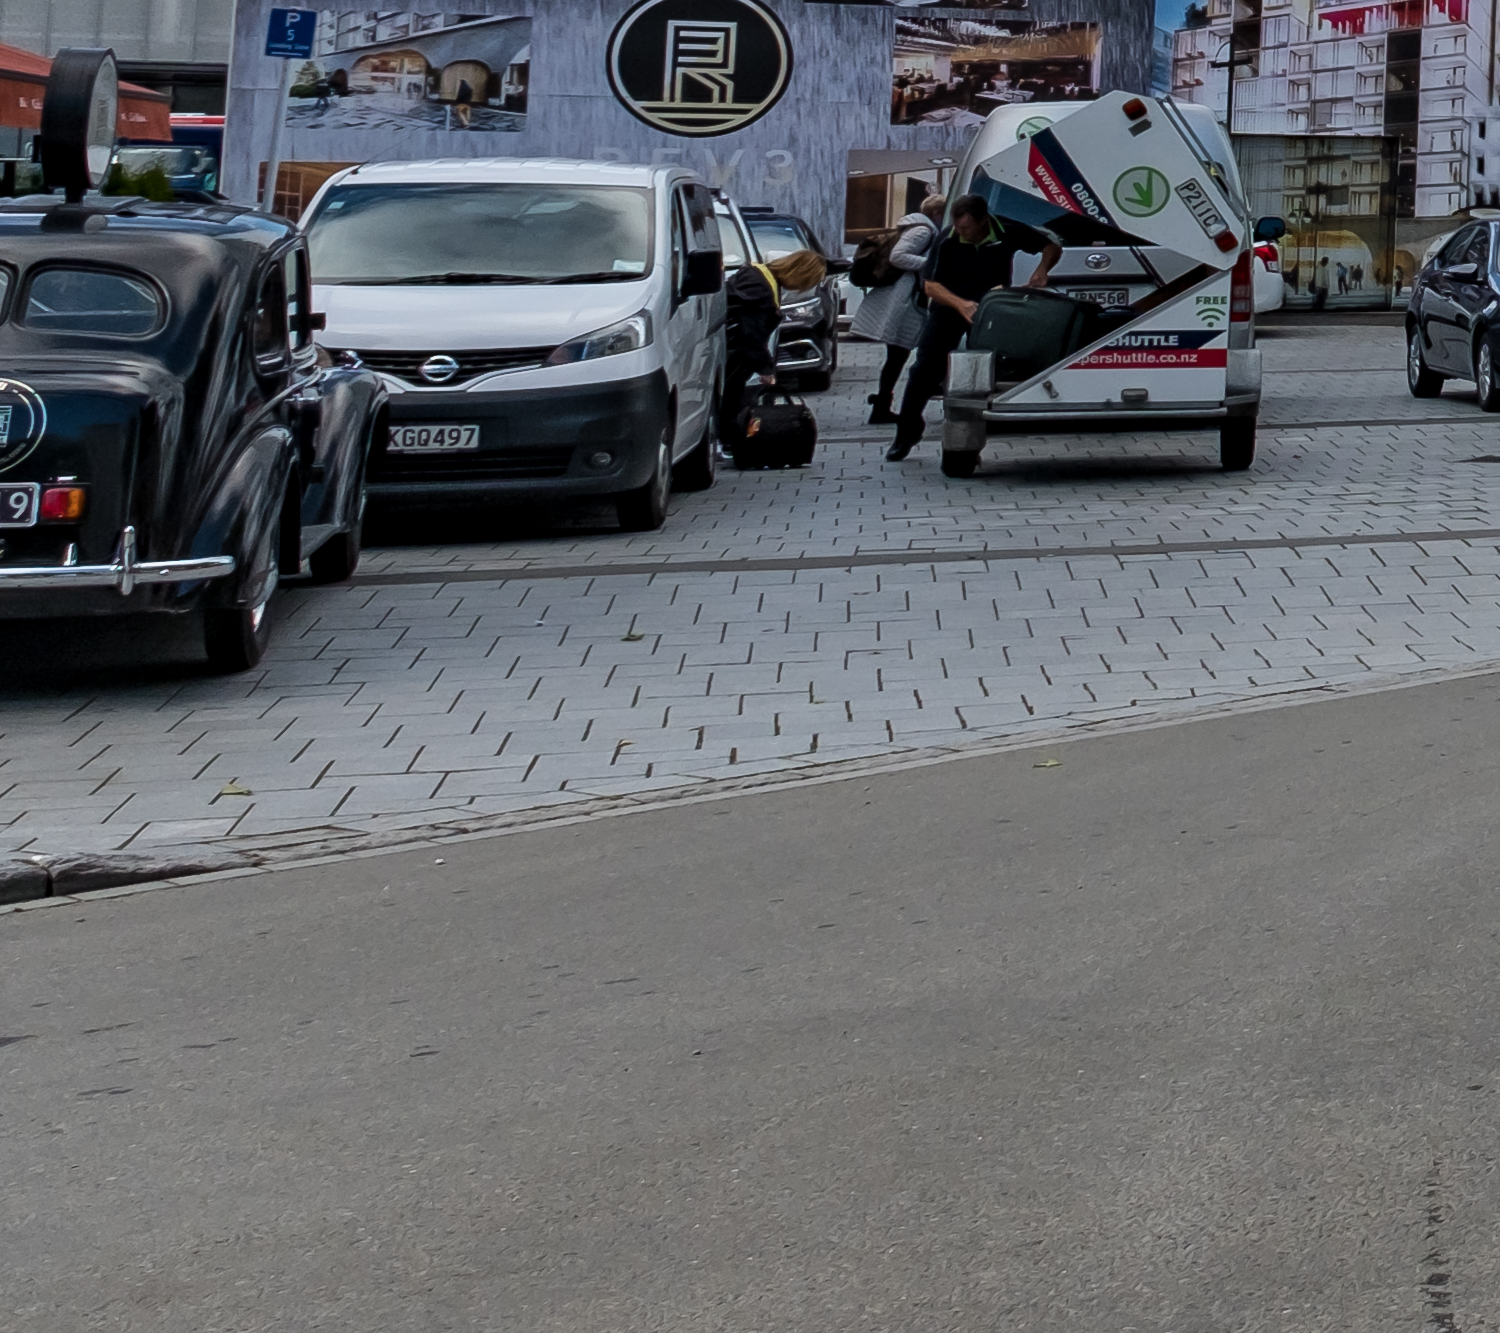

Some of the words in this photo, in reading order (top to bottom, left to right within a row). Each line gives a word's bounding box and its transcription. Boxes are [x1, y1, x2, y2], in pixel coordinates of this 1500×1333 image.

[285, 12, 301, 27] P
[287, 29, 295, 41] 5
[1195, 296, 1228, 305] FREE
[1077, 352, 1198, 366] pershuttle.co.nz
